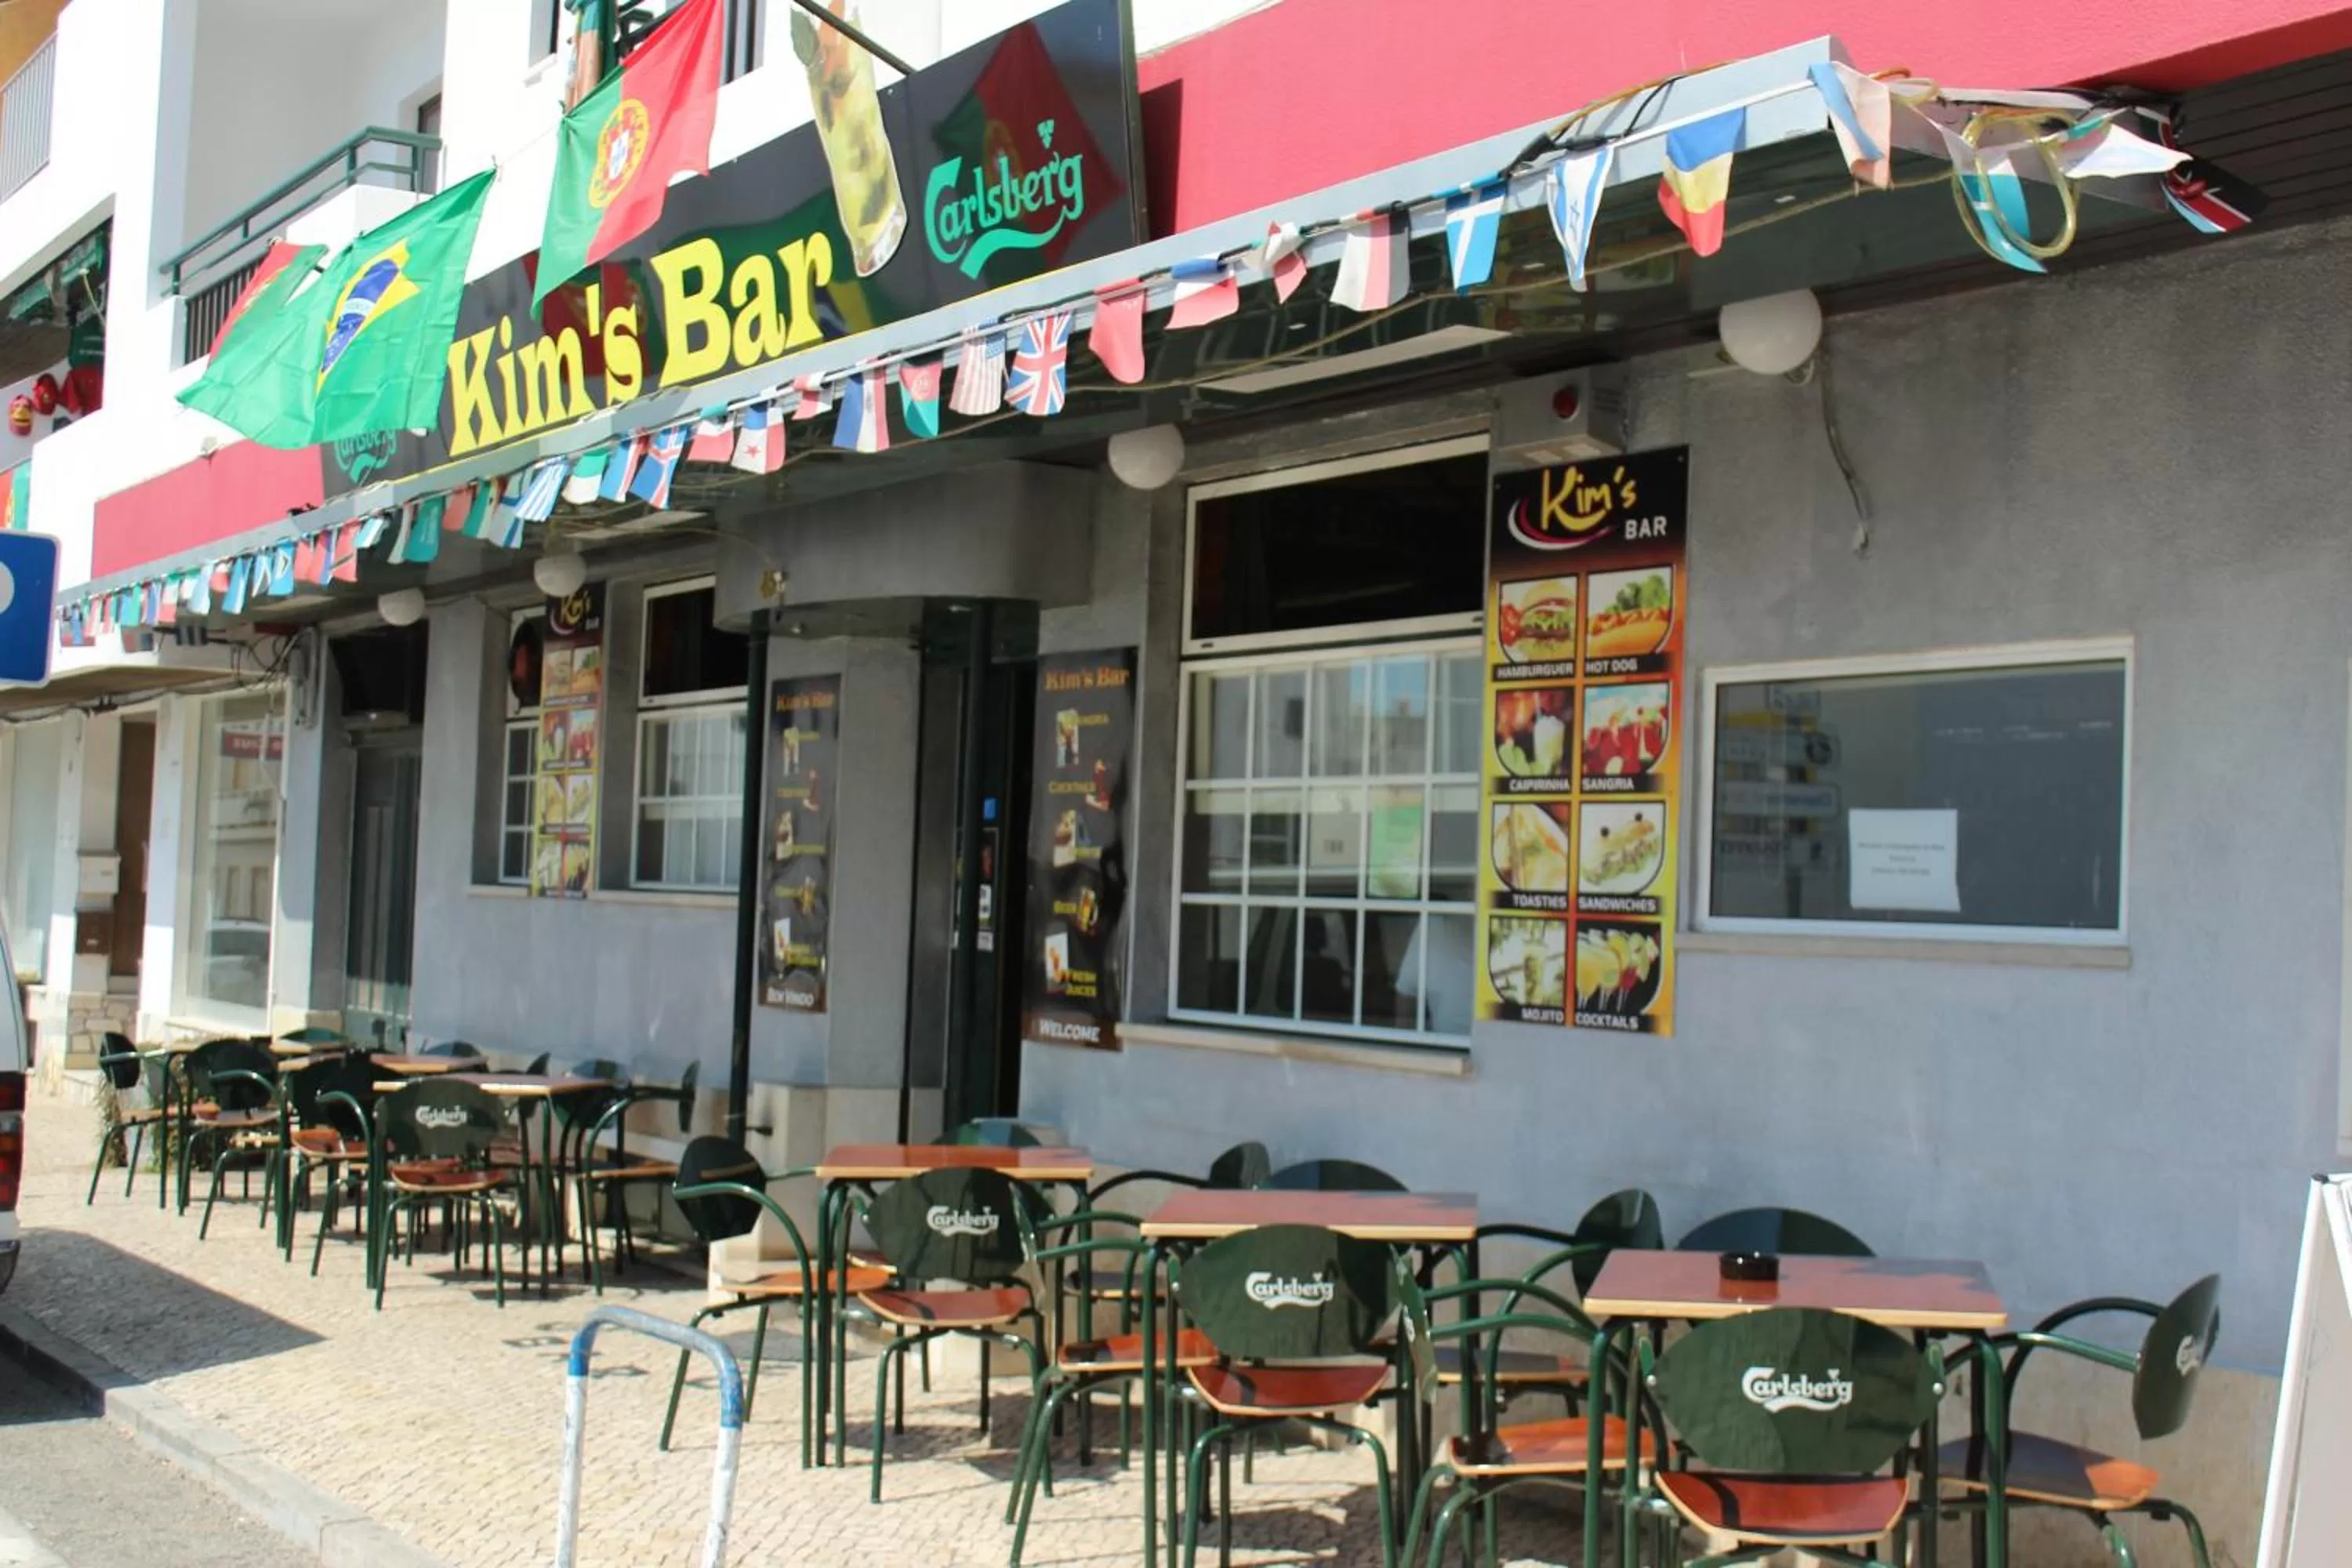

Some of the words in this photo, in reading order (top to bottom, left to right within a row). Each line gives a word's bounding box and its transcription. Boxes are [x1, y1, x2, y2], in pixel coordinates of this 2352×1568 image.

[924, 151, 1083, 279] Carlsberg
[448, 283, 643, 456] Kim's
[651, 232, 833, 387] Bar
[1541, 466, 1637, 531] Kim's
[1624, 515, 1668, 539] BAR
[1098, 666, 1130, 688] Bar
[1586, 660, 1610, 673] HOT
[1611, 658, 1639, 672] DOG
[1581, 777, 1635, 791] SANGRIA
[1512, 894, 1567, 909] TOASTIES
[1578, 896, 1657, 913] SANDWICHES
[1521, 1008, 1565, 1023] MOJITO
[1575, 1013, 1639, 1030] COCKTAILS
[926, 1205, 1000, 1237] Carlsberg
[1245, 1270, 1334, 1310] Carlsberg
[1741, 1366, 1853, 1414] Carlsberg
